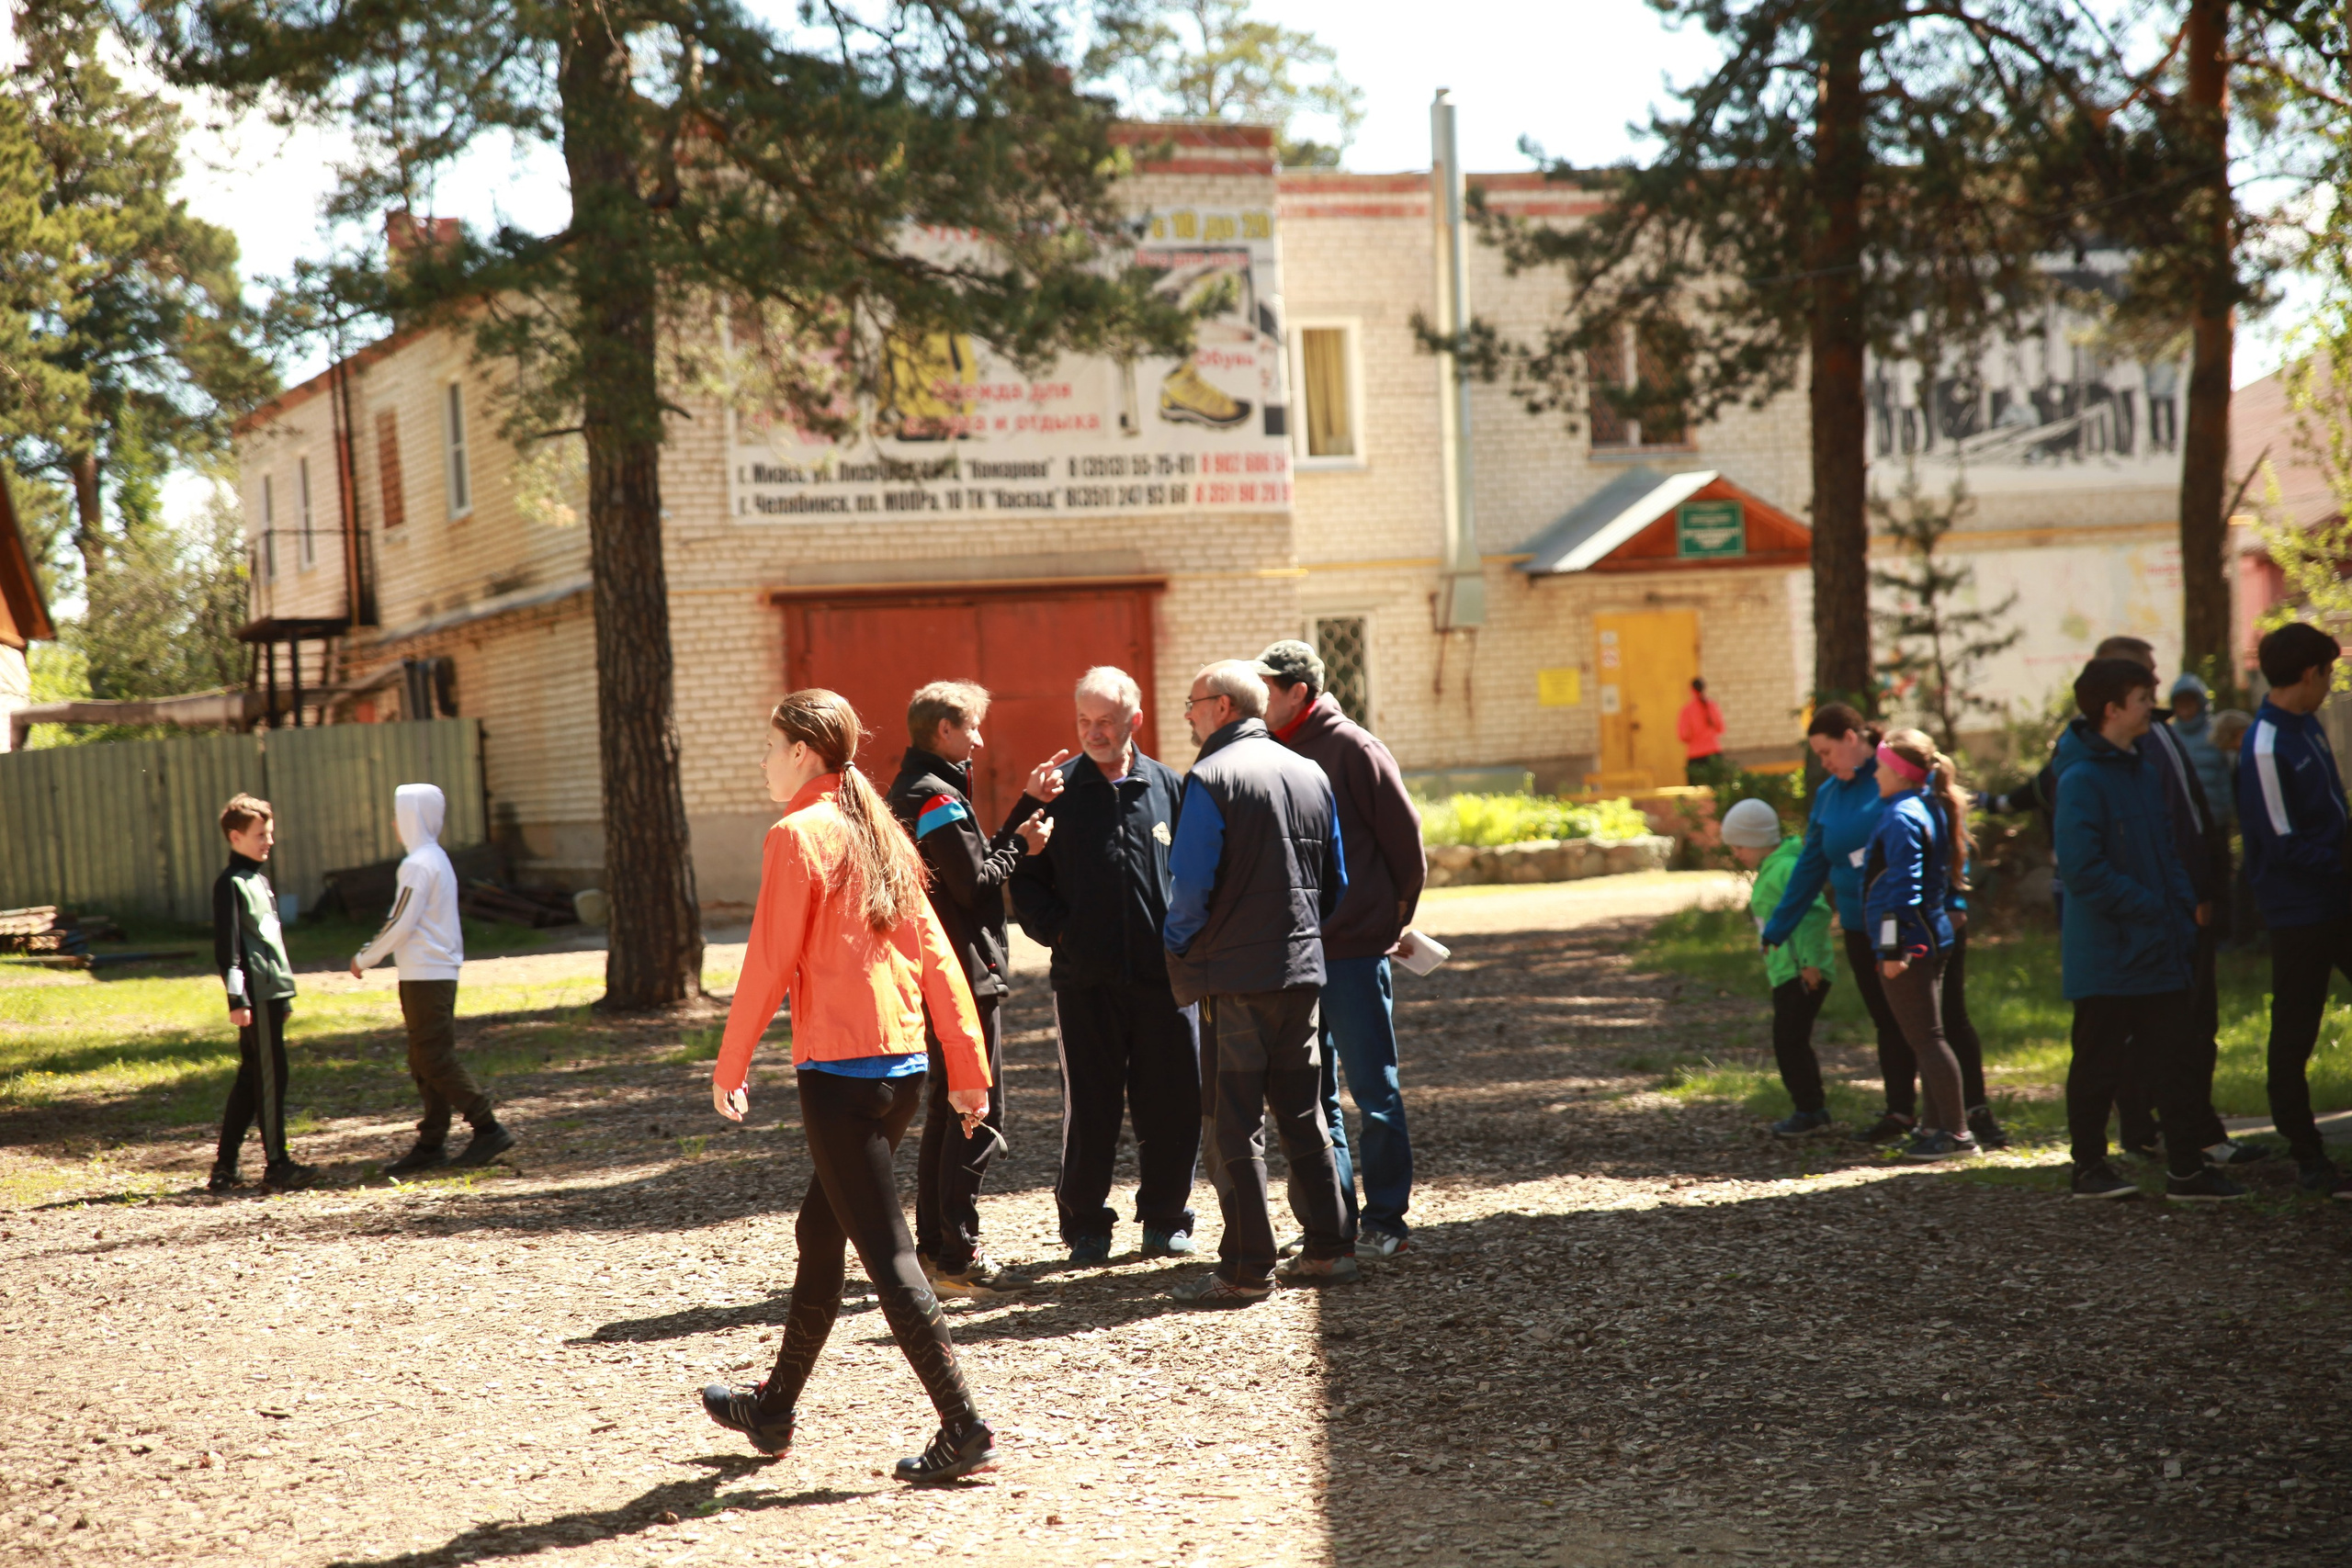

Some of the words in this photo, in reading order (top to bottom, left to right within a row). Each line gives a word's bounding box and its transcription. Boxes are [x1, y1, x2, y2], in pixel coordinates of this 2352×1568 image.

[1171, 211, 1195, 239] 10
[1203, 216, 1235, 242] до
[1242, 211, 1271, 239] 20
[1195, 349, 1254, 370] Обувь
[1031, 383, 1073, 401] для
[995, 416, 1008, 431] и
[1015, 413, 1100, 433] отдыха
